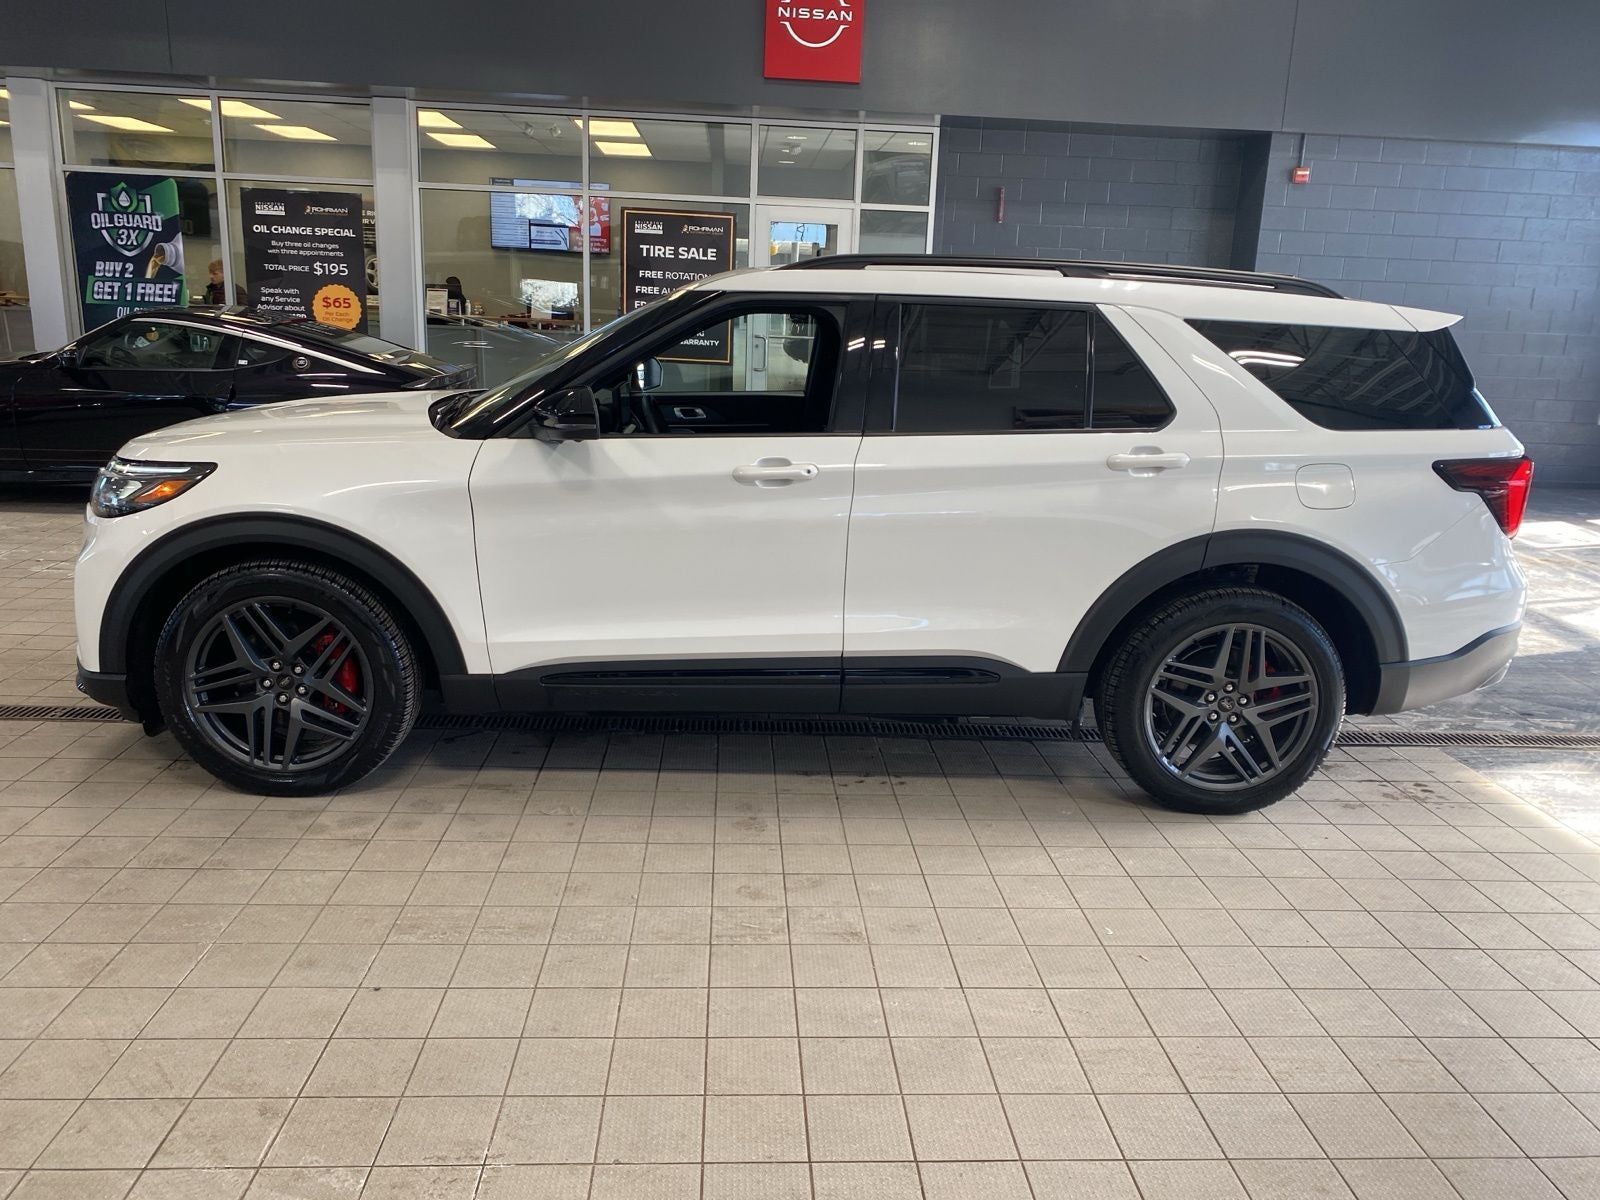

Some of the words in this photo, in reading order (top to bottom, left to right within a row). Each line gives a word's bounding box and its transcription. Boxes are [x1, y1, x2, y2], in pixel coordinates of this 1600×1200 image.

[778, 6, 853, 21] NISSAN
[90, 212, 162, 232] OILGUARD
[252, 224, 270, 234] OIL
[271, 225, 313, 235] CHANGE
[314, 227, 356, 238] SPECIAL
[688, 225, 724, 233] ROHRMAN
[117, 229, 139, 246] 3X
[271, 240, 285, 249] Buy
[285, 240, 302, 248] three
[303, 240, 311, 248] oil
[312, 241, 340, 250] changes
[640, 245, 675, 258] TIRE
[678, 247, 717, 260] SALE
[95, 261, 123, 278] BUY
[124, 262, 134, 278] 2
[263, 263, 287, 271] TOTAL
[288, 264, 310, 273] PRICE
[313, 260, 349, 276] $195
[639, 270, 664, 279] FREE
[93, 281, 121, 300] GET
[125, 282, 133, 301] 1
[136, 282, 179, 303] FREE!
[260, 286, 282, 295] Speak
[283, 287, 300, 295] with
[635, 285, 660, 295] FREE
[275, 295, 301, 304] Service
[322, 296, 352, 309] $65
[257, 303, 283, 311] Advisor
[284, 304, 306, 312] about
